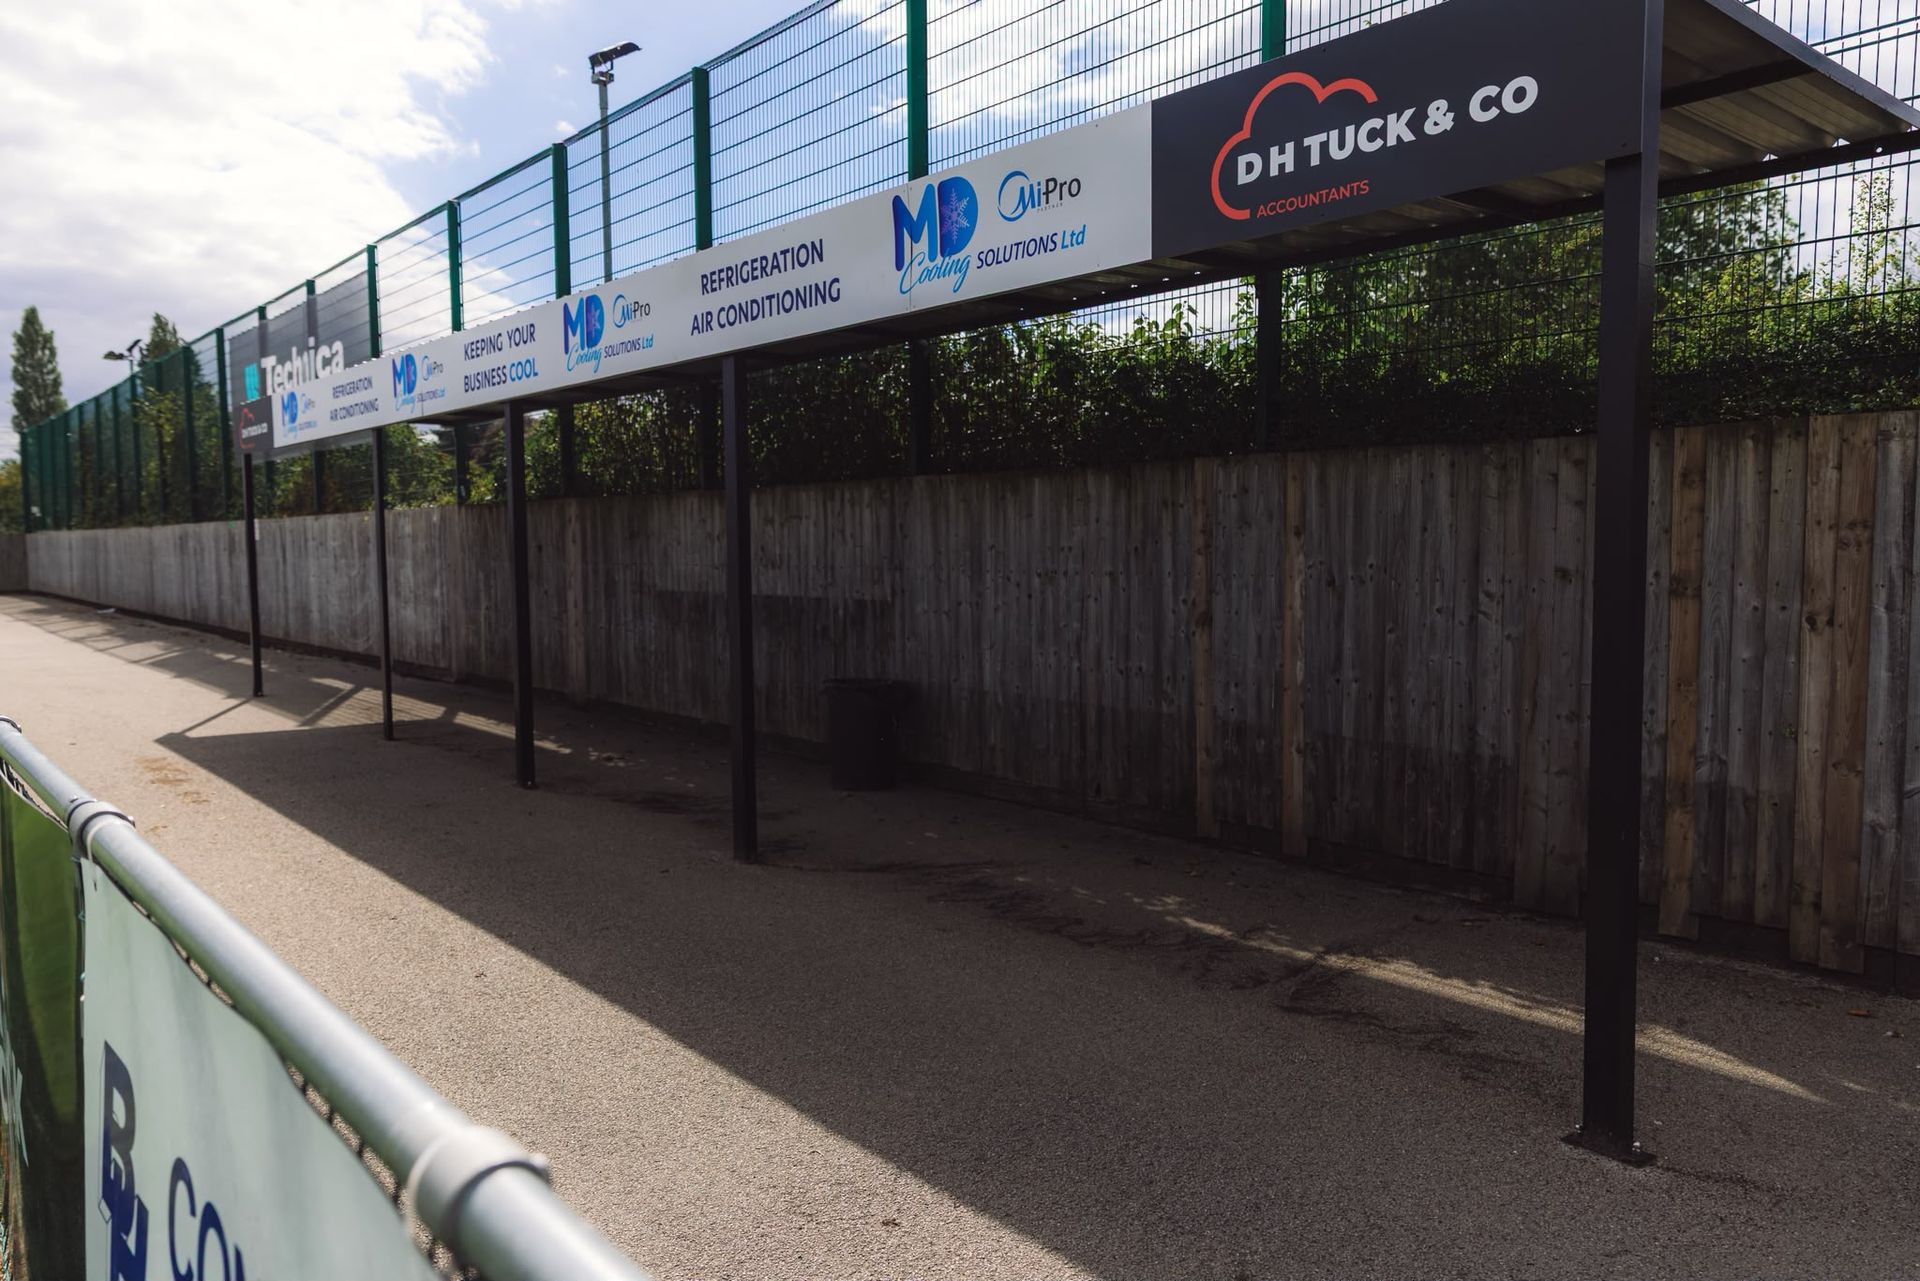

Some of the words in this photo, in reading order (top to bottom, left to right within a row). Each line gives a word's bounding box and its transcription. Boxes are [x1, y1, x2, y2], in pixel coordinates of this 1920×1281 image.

[1303, 107, 1416, 166] TUCK
[1424, 98, 1455, 136] &
[1469, 75, 1539, 123] CO
[997, 170, 1082, 222] MiPro
[1256, 179, 1370, 218] ACCOUNTANTS
[892, 175, 979, 272] MD
[700, 238, 824, 296] REFRIGERATION
[899, 250, 972, 295] Cooling
[976, 232, 1058, 270] SOLUTIONS
[1061, 224, 1086, 251] Ltd
[563, 293, 605, 355] MD
[690, 309, 714, 336] AIR
[717, 277, 841, 329] CONDITIONING
[261, 336, 345, 396] Technica
[464, 332, 503, 361] KEEPING
[506, 323, 536, 349] YOUR
[566, 347, 602, 374] Cooling
[604, 337, 641, 359] SOLUTIONS
[641, 334, 654, 350] Ltd
[332, 376, 373, 399] REFRIGERATION
[391, 353, 417, 399] MD
[464, 364, 507, 393] BUSINESS
[509, 357, 539, 383] COOL
[339, 398, 379, 420] CONDITIONING
